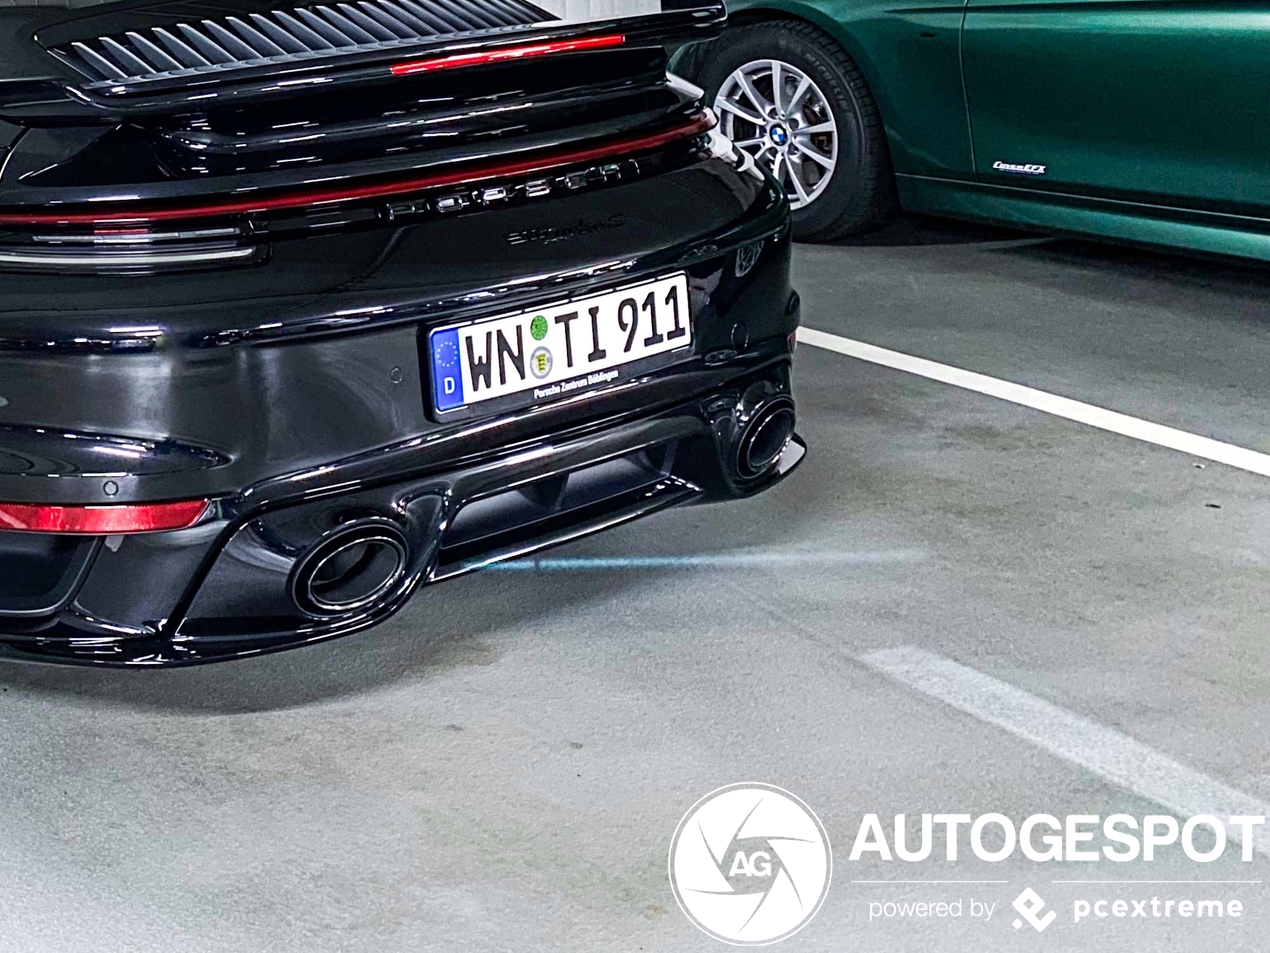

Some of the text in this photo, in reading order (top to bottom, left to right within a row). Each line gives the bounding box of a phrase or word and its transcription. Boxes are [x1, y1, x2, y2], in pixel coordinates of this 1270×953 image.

[465, 285, 686, 392] WN TI 911
[444, 376, 456, 395] D
[533, 369, 619, 400] Porsche Zentrum Böblingen
